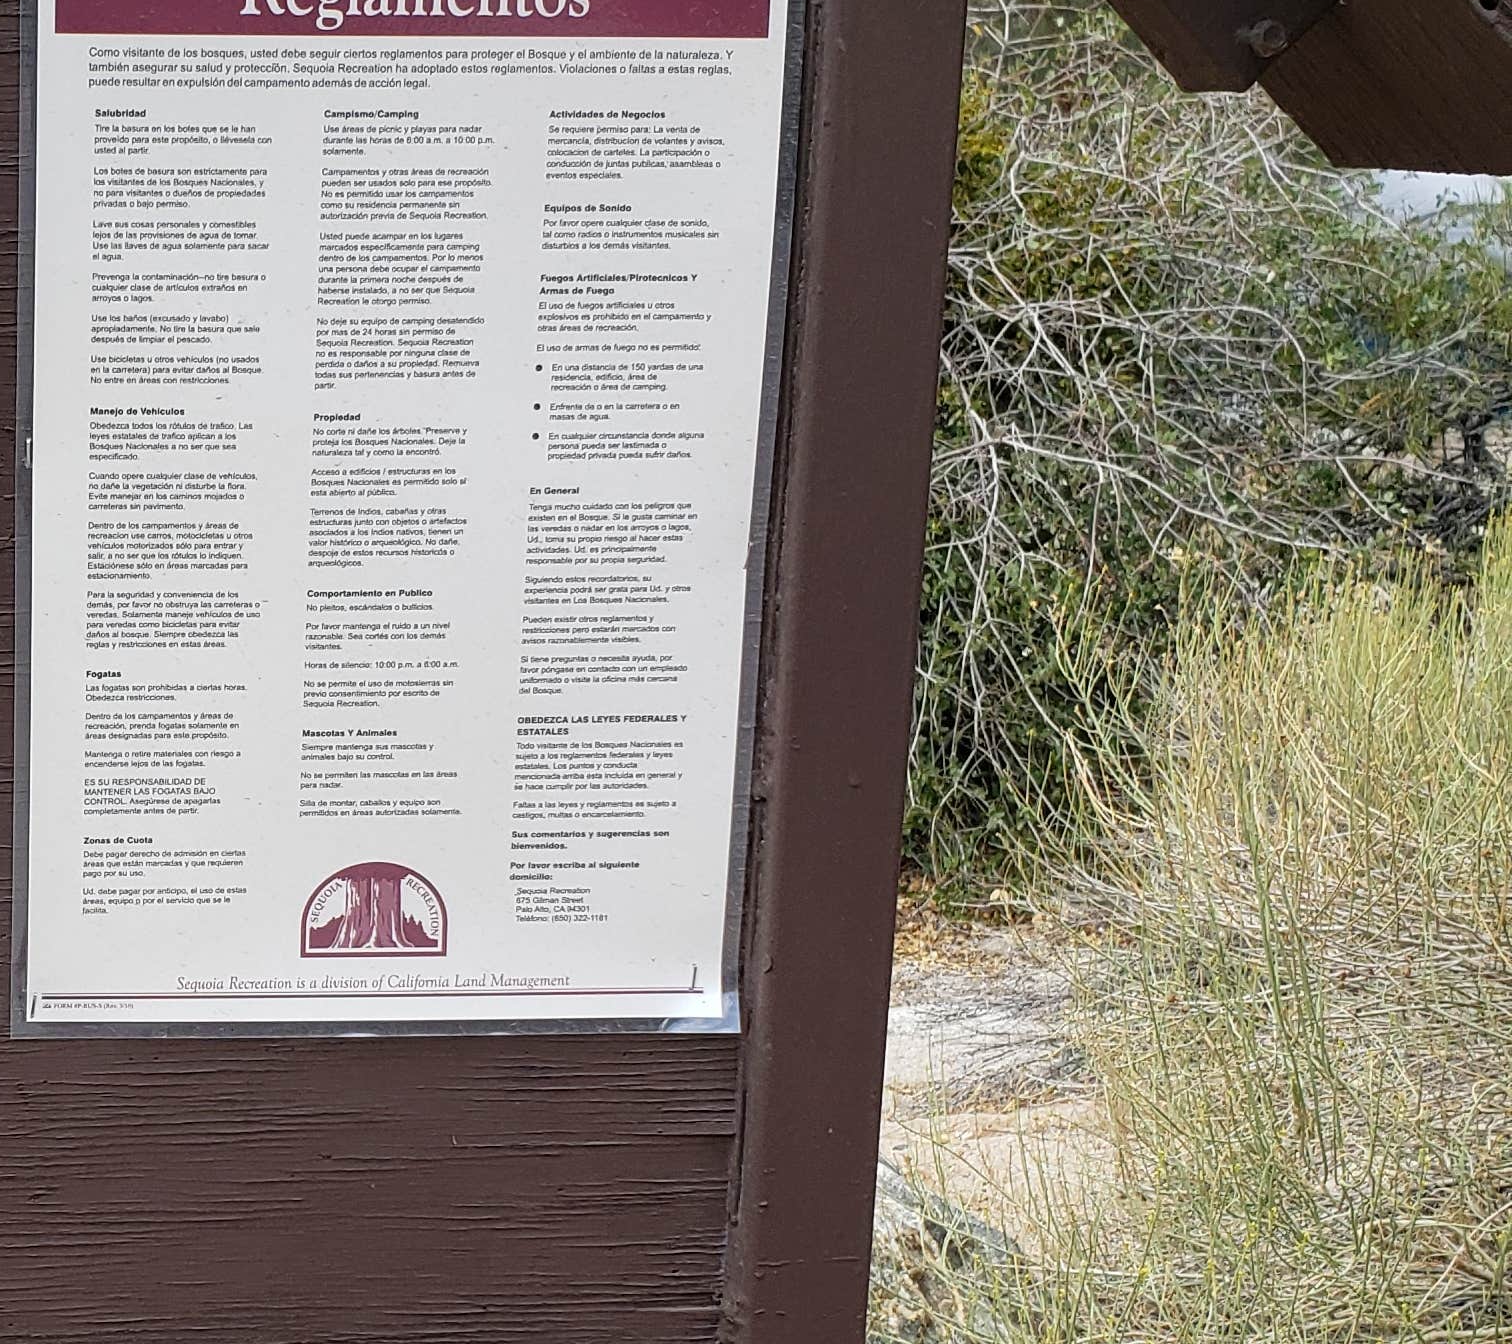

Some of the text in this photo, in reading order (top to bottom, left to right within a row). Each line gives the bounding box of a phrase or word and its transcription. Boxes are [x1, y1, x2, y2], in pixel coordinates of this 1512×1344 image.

[87, 76, 431, 90] puede resultar en expulsión del campamento además de acción legal.
[94, 108, 147, 117] Salubridad
[323, 108, 419, 120] Campismo/Camping
[548, 110, 666, 120] Actividades de Negocios
[543, 203, 632, 214] Equipos de Sonido
[539, 273, 574, 284] Fuegos
[690, 273, 698, 281] Y
[538, 286, 615, 296] Armas de Fuego
[89, 407, 124, 417] Manejo
[125, 407, 138, 415] de
[312, 412, 361, 423] Propiedad
[529, 486, 580, 495] En General
[306, 589, 383, 599] Comportamiento
[85, 670, 122, 679] Fogatas
[301, 728, 345, 737] Mascotas
[355, 728, 397, 736] Animales
[82, 836, 153, 844] Zonas de Cuota
[310, 881, 343, 924] SEQUOIA
[405, 877, 440, 937] RECREATION
[175, 972, 570, 991] Sequoia Recreation is a division of California Land Management
